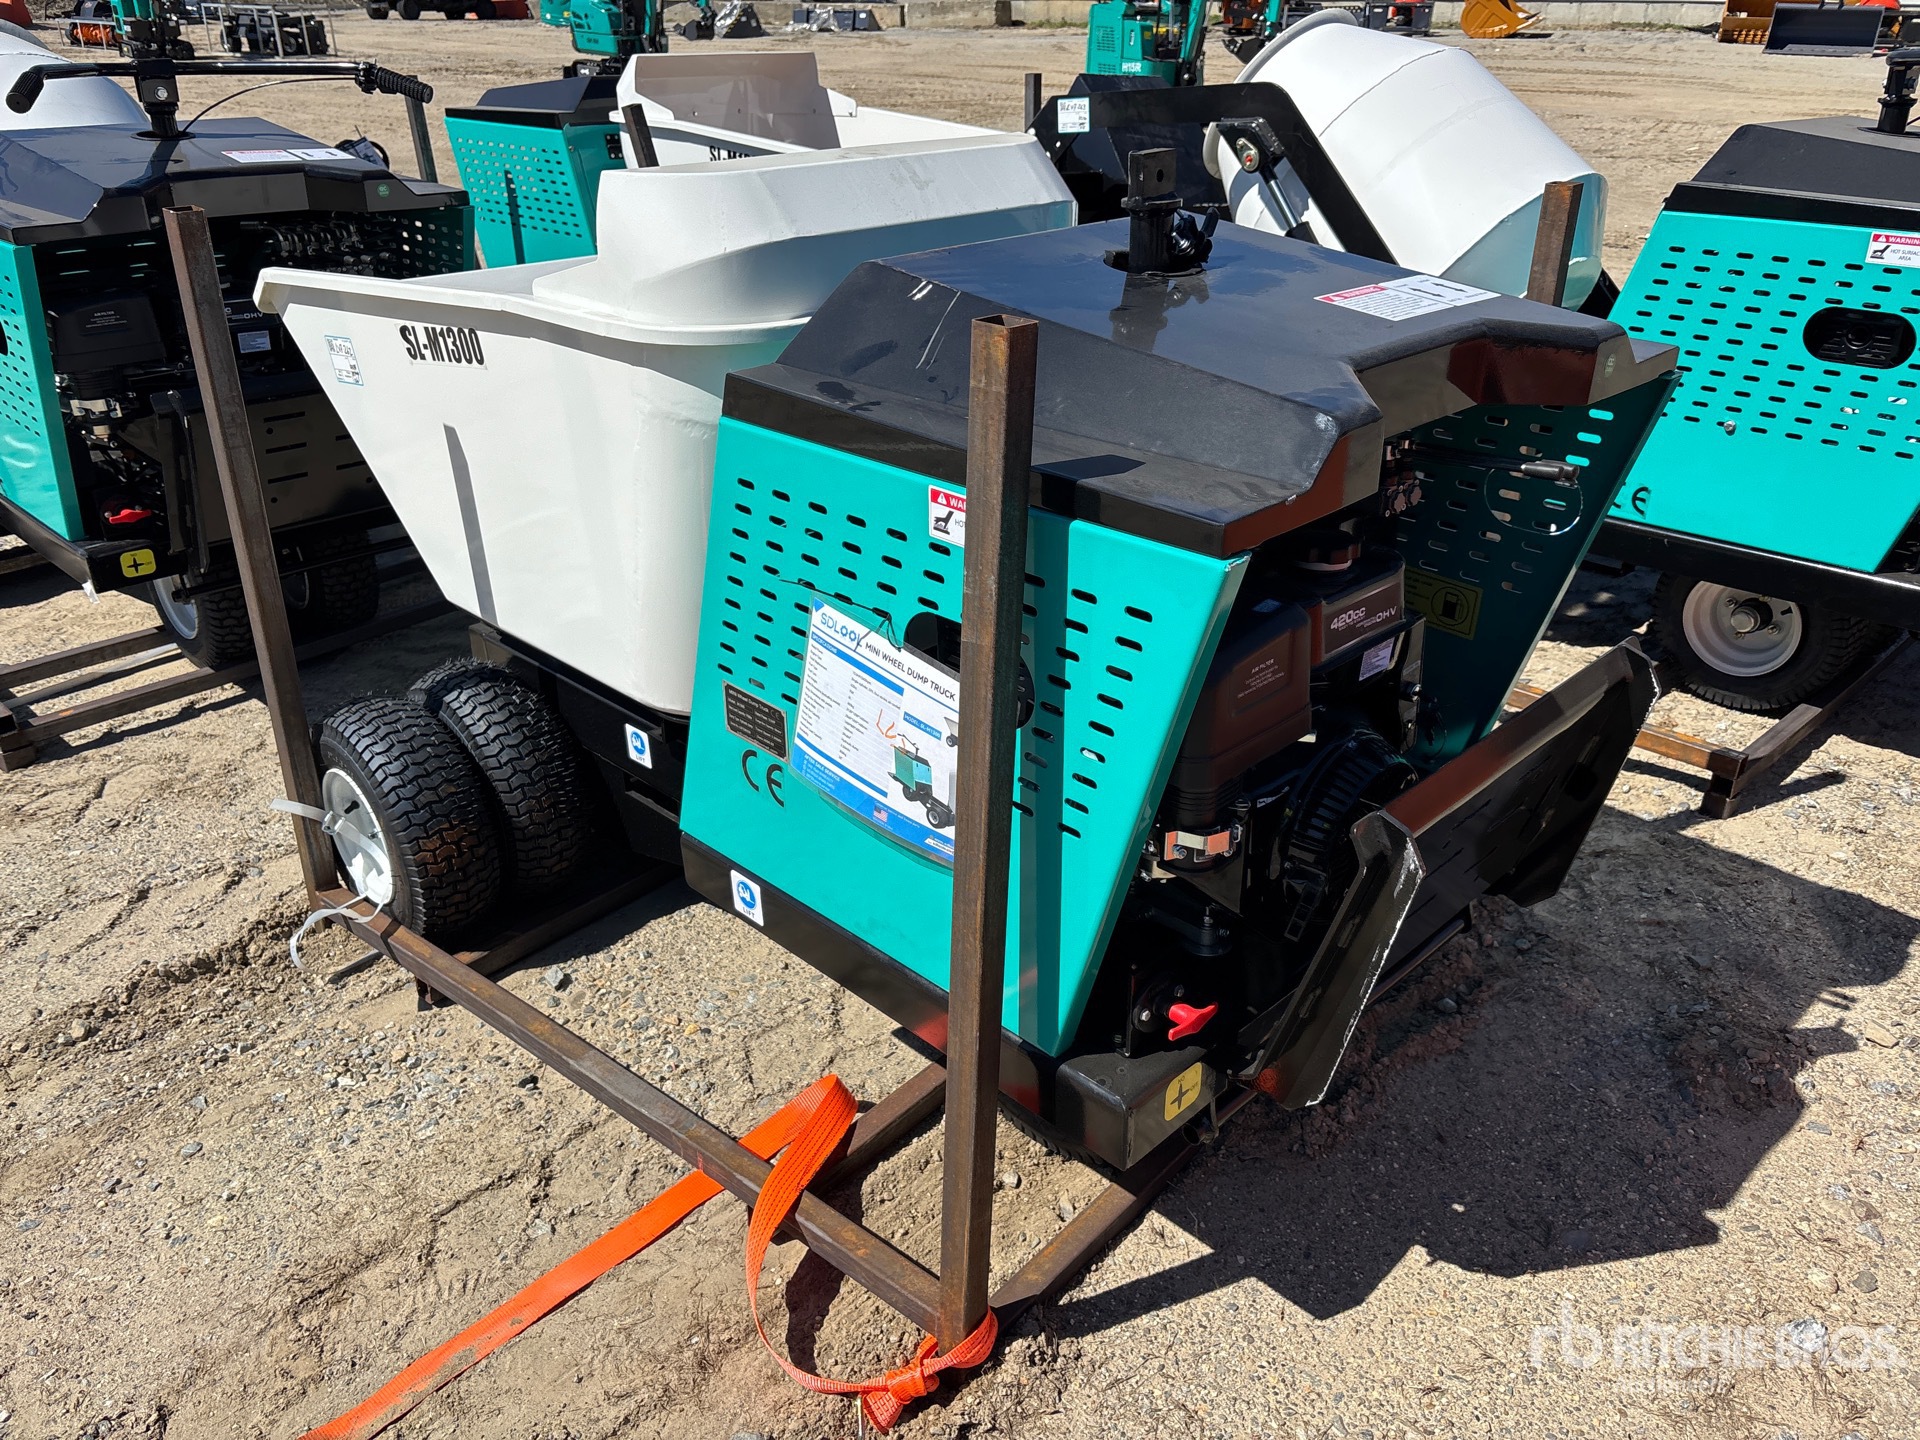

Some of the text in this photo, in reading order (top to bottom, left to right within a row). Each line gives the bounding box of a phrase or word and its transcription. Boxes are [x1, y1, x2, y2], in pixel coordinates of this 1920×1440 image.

[1889, 236, 1920, 245] WARNIN
[399, 324, 485, 366] SL-M1300
[1330, 607, 1366, 630] 420cc
[1376, 605, 1398, 623] OHV
[865, 642, 881, 657] MINI
[882, 653, 906, 673] WHEEL
[907, 667, 929, 685] DUMP
[930, 680, 956, 702] TRUCK
[741, 748, 785, 808] CE
[742, 906, 755, 919] LIFT
